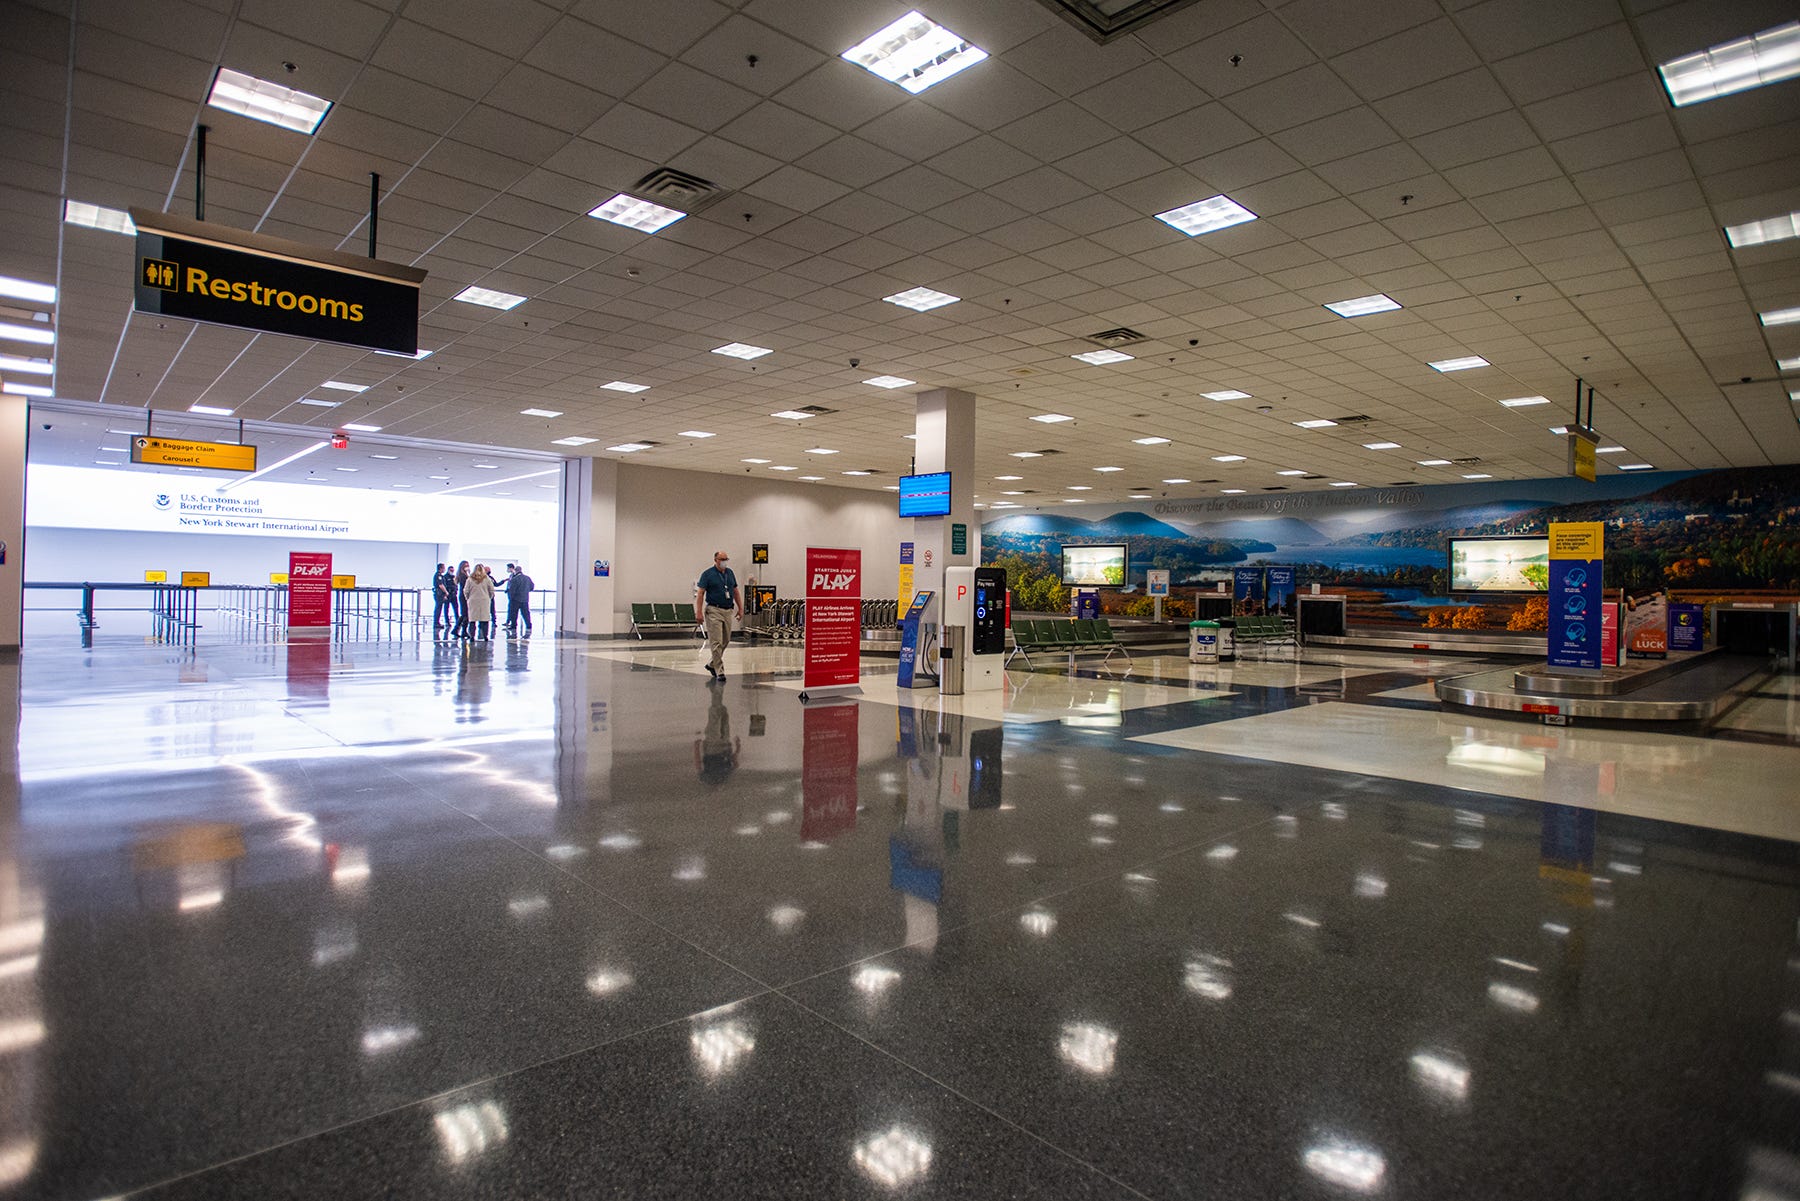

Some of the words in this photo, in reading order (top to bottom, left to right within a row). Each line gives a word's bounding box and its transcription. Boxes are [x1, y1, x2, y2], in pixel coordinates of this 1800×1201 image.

[186, 267, 364, 322] Restrooms
[162, 442, 193, 451] Baggage
[196, 443, 215, 453] Claim
[162, 455, 194, 463] Carousel
[180, 494, 198, 502] U.S.
[201, 495, 240, 505] Customs
[243, 498, 260, 506] and
[1154, 501, 1202, 514] Discover
[1206, 499, 1225, 512] the
[1226, 499, 1271, 513] Beauty
[1273, 495, 1290, 513] of
[1292, 494, 1312, 509] the
[1316, 494, 1370, 506] Hudson
[1375, 489, 1425, 508] Valley
[180, 502, 212, 511] Border
[215, 504, 263, 514] Protection
[180, 517, 200, 526] New
[202, 518, 223, 527] York
[225, 519, 259, 529] Stewart
[262, 522, 318, 532] International
[319, 524, 349, 534] Airport
[293, 566, 327, 576] PLAY
[811, 574, 856, 590] PLAY
[957, 585, 967, 601] P
[1636, 640, 1664, 649] LUCK
